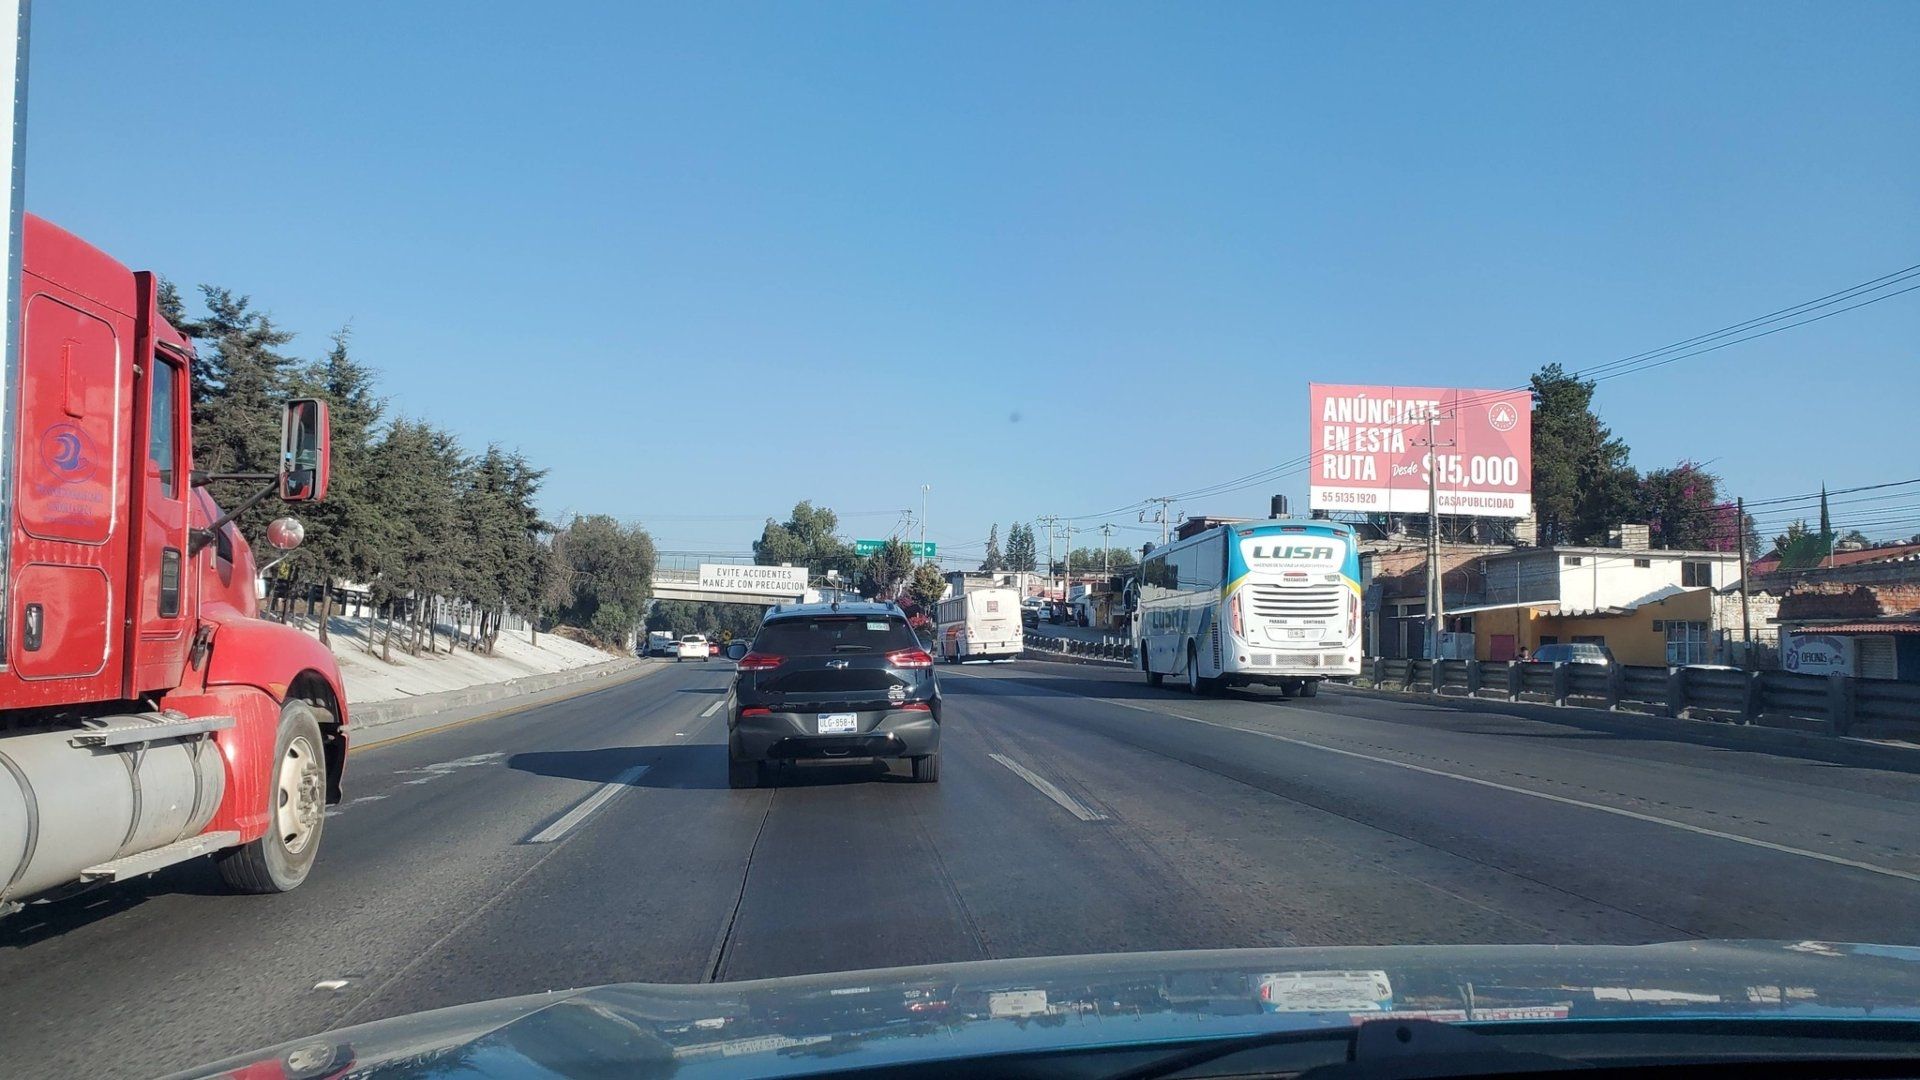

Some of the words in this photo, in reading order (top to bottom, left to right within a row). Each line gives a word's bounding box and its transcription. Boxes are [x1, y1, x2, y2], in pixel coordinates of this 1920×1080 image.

[1323, 394, 1440, 425] ANÚNCIATE
[1324, 426, 1349, 451] EN
[1355, 427, 1405, 453] ESTA
[1323, 453, 1377, 480] RUTA
[1392, 461, 1418, 477] Desde
[1421, 452, 1518, 487] $15,000
[1322, 492, 1333, 502] 55
[1335, 492, 1355, 503] 5135
[1356, 493, 1377, 504] 1920
[1253, 546, 1334, 559] LUSA
[717, 568, 740, 577] EVITE
[743, 569, 792, 579] ACCIDENTES
[702, 579, 735, 588] MANEJE
[737, 580, 753, 589] CON
[755, 581, 804, 590] PRECAUCION
